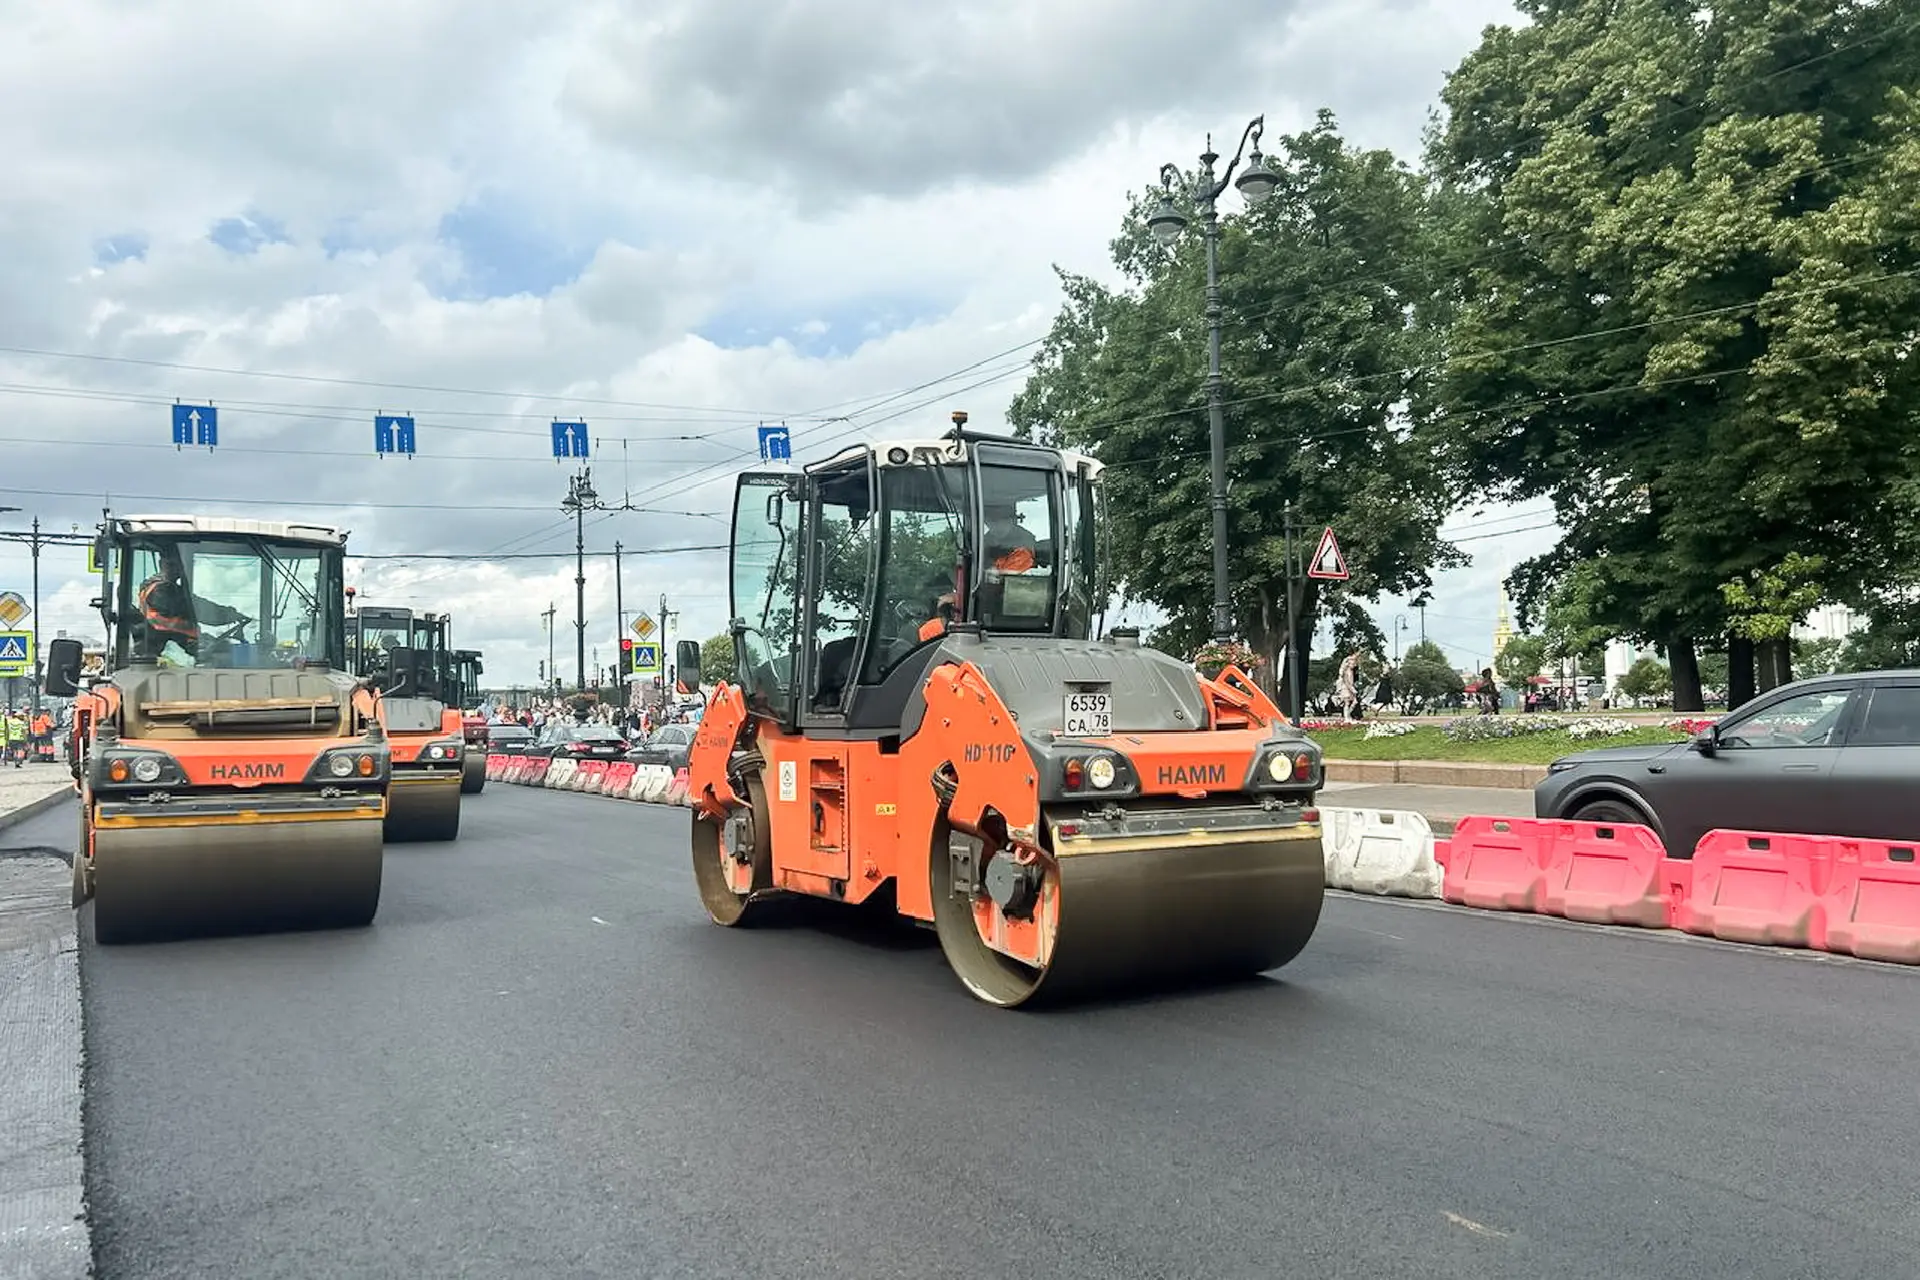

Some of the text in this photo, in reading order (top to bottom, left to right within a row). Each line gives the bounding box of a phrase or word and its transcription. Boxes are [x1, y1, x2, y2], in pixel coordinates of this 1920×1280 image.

[1070, 695, 1106, 712] 6539
[1094, 714, 1109, 728] 78
[210, 762, 285, 779] HAMM
[1158, 764, 1226, 785] HAMM
